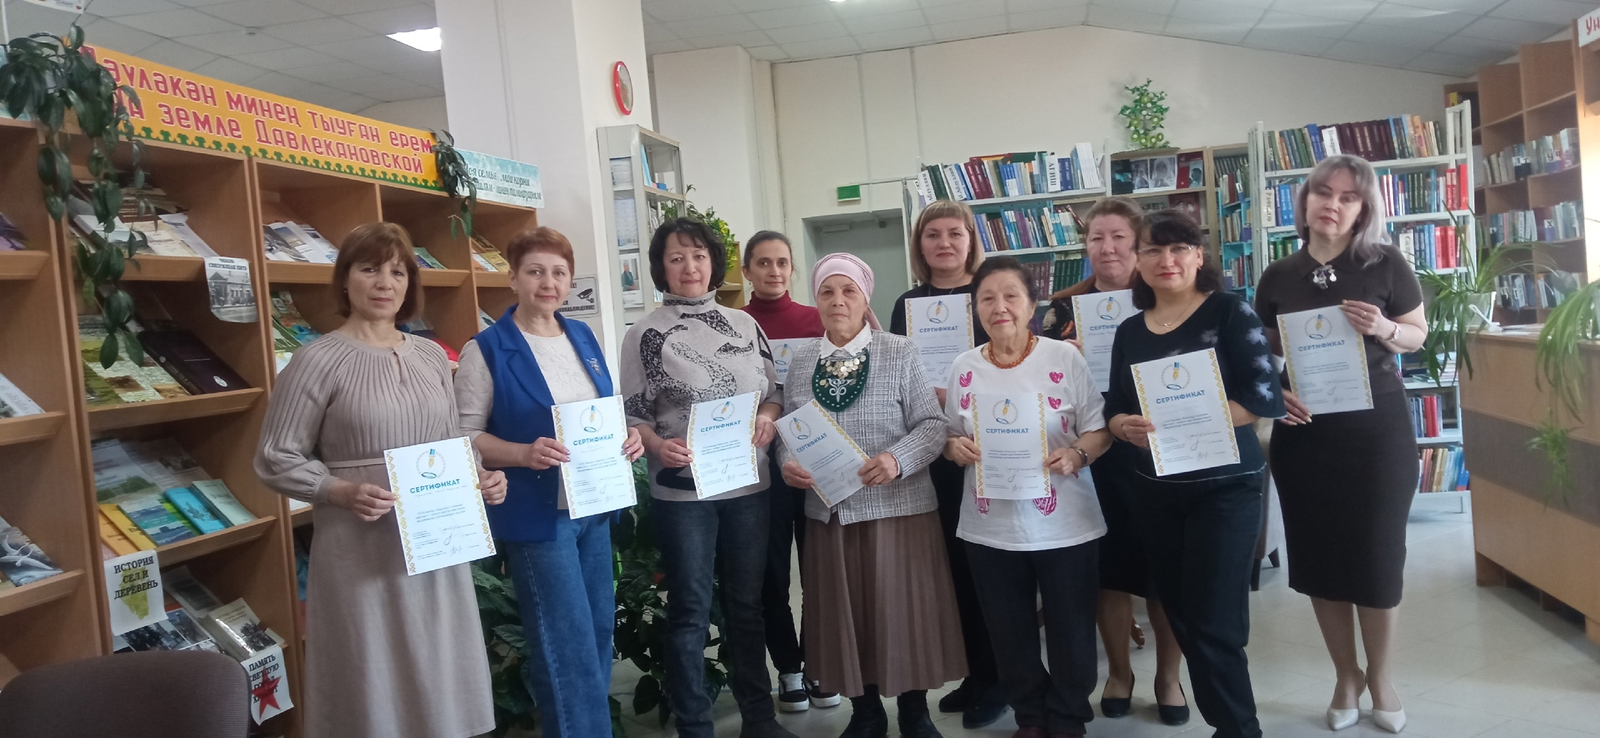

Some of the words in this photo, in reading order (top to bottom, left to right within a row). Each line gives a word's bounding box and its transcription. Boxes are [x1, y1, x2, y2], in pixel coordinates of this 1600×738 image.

[157, 102, 242, 139] земле
[254, 118, 424, 174] Давлекановской
[918, 325, 958, 333] СЕРТИФИКАТ
[1298, 339, 1345, 352] СЕРТИФИКАТ
[1156, 389, 1205, 404] СЕРТИФИКАТ
[700, 420, 742, 433] СЕРТИФИКАТ
[409, 478, 461, 494] СЕРТИФИКАТ
[114, 556, 154, 574] ИСТОРИЯ
[122, 572, 140, 584] СЕЛ
[114, 580, 158, 600] ДЕРЕВЕНЬ
[249, 654, 276, 672] ПАМЯТЬ
